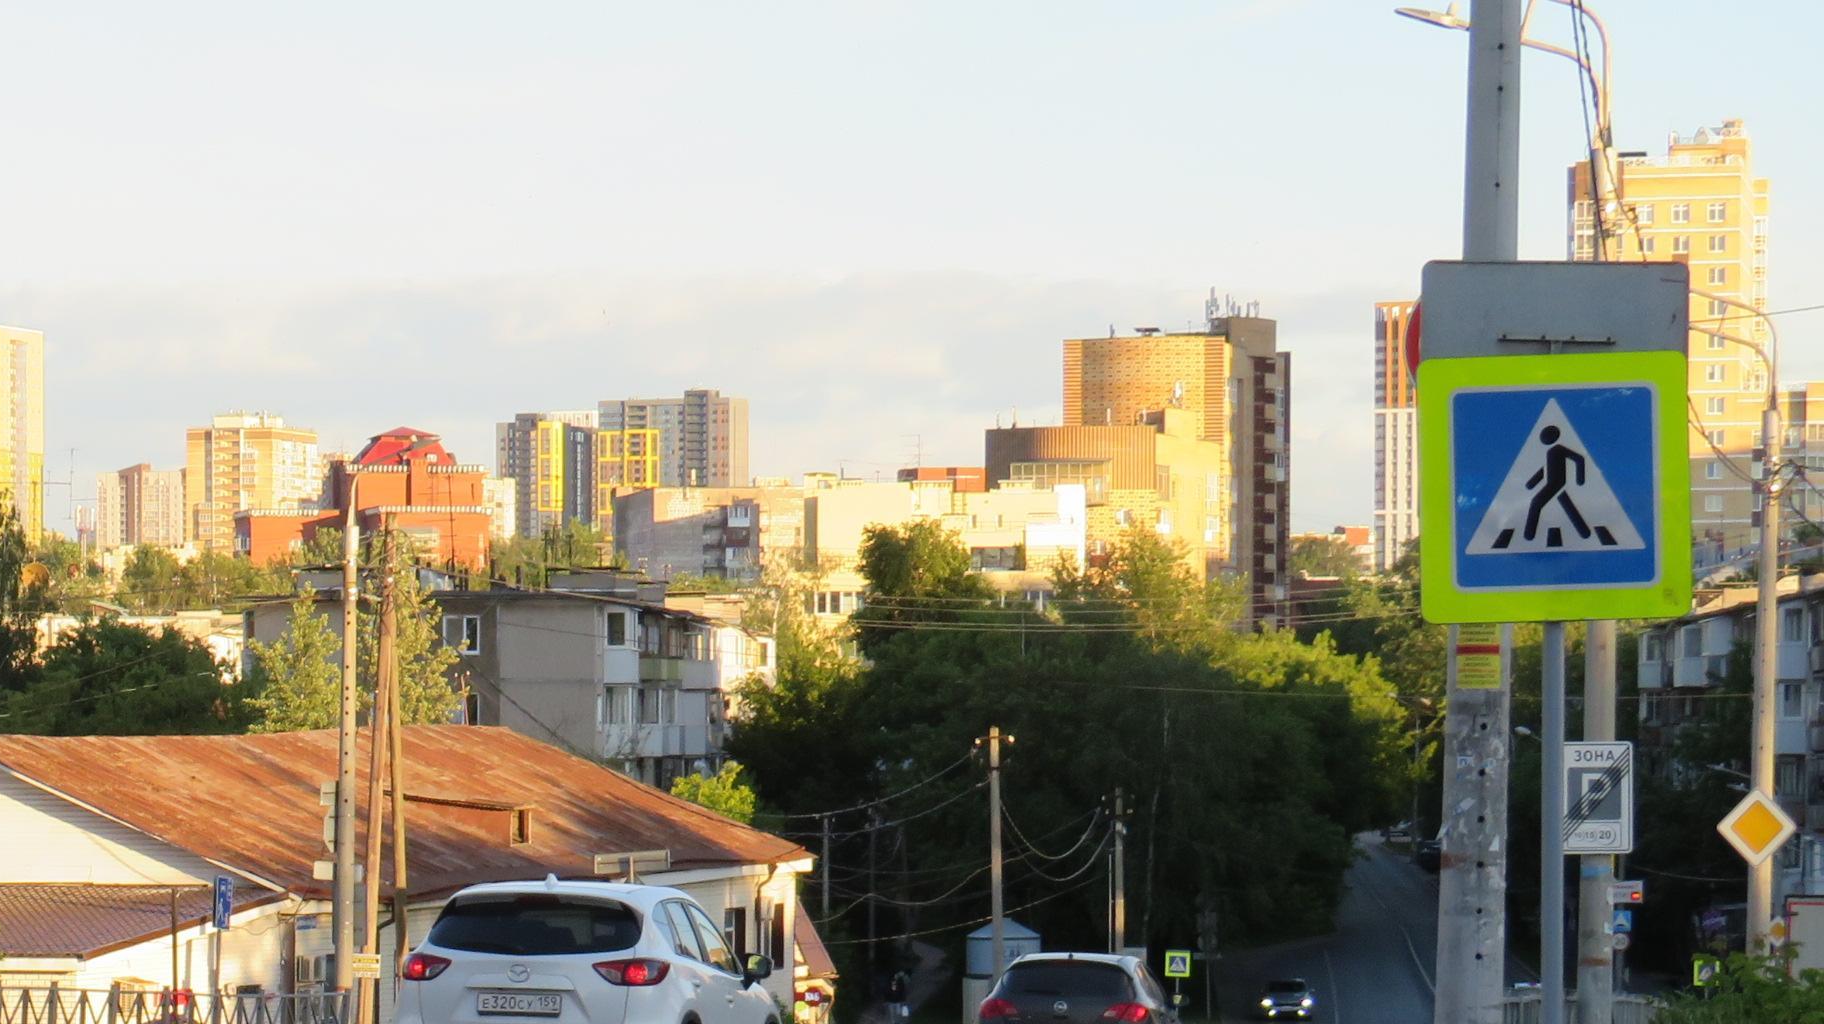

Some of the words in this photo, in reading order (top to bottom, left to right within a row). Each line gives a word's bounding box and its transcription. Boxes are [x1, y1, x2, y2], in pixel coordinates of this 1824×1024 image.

[1574, 750, 1615, 762] ЗОНА
[1599, 830, 1611, 840] 20
[537, 996, 558, 1008] 159
